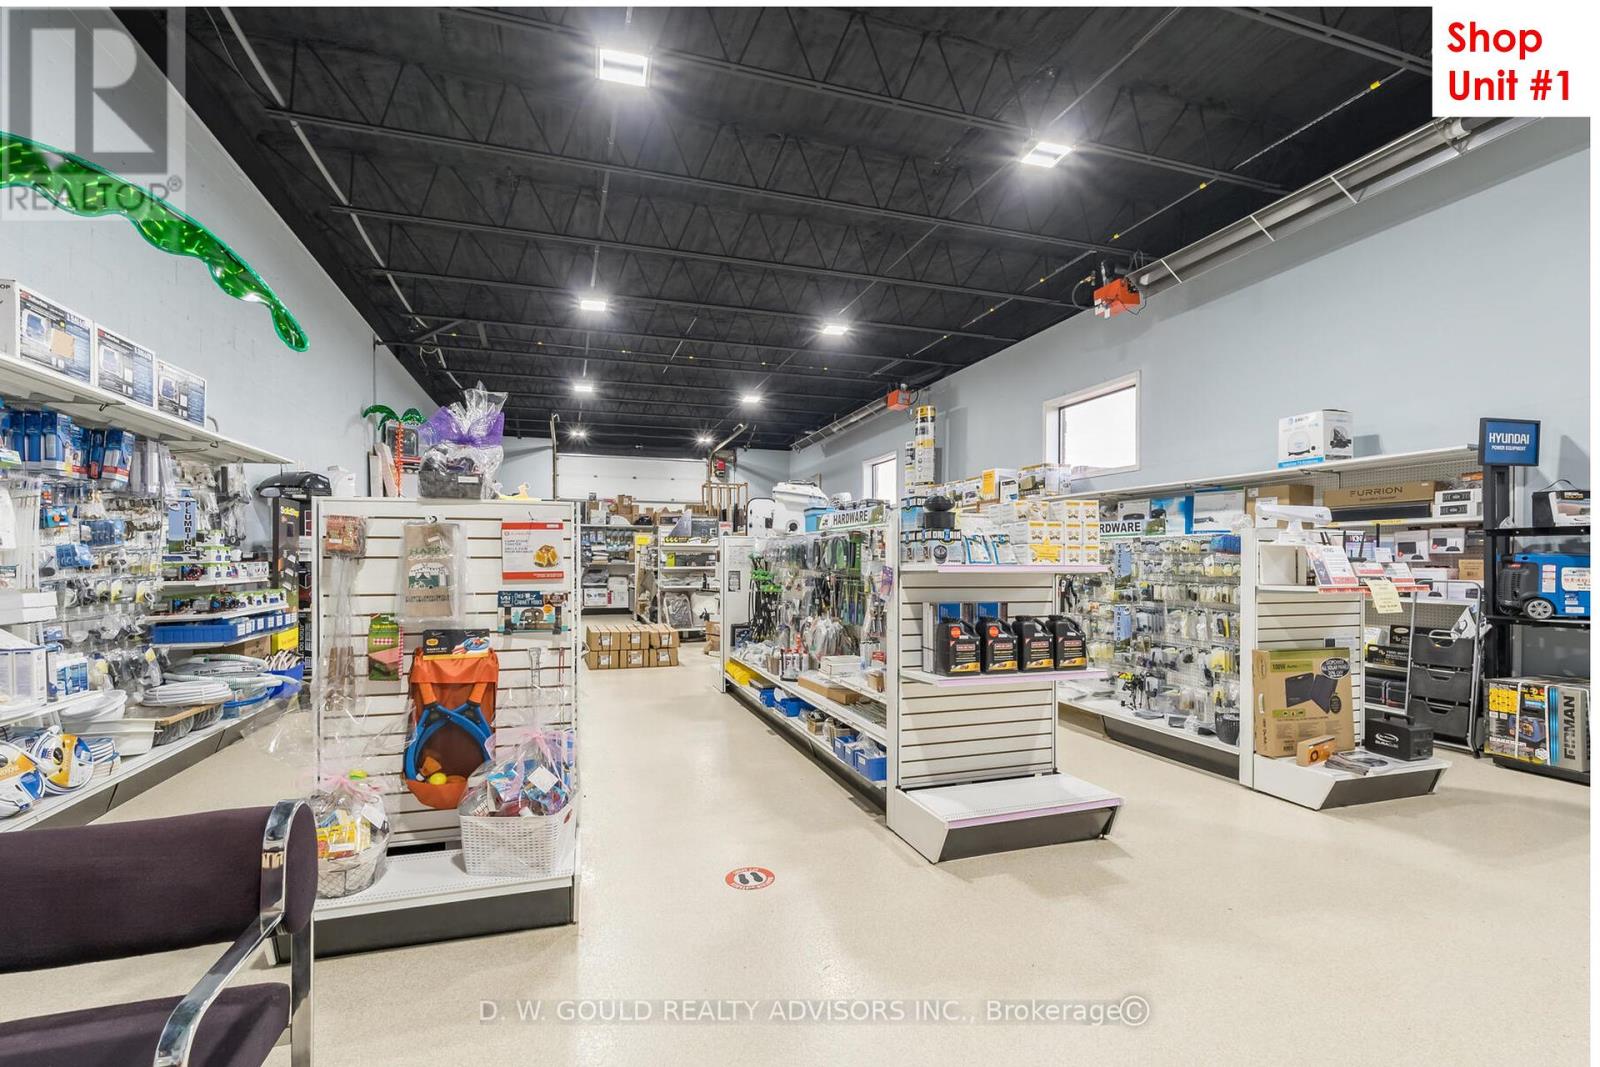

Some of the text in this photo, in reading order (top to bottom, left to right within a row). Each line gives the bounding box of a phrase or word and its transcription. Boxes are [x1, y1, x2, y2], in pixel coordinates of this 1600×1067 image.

[1489, 432, 1530, 445] HYUNDAI
[1350, 486, 1403, 498] FURRION
[833, 510, 868, 526] HARDWARE
[184, 501, 192, 551] PLUMBING
[1099, 521, 1141, 534] RDWARE
